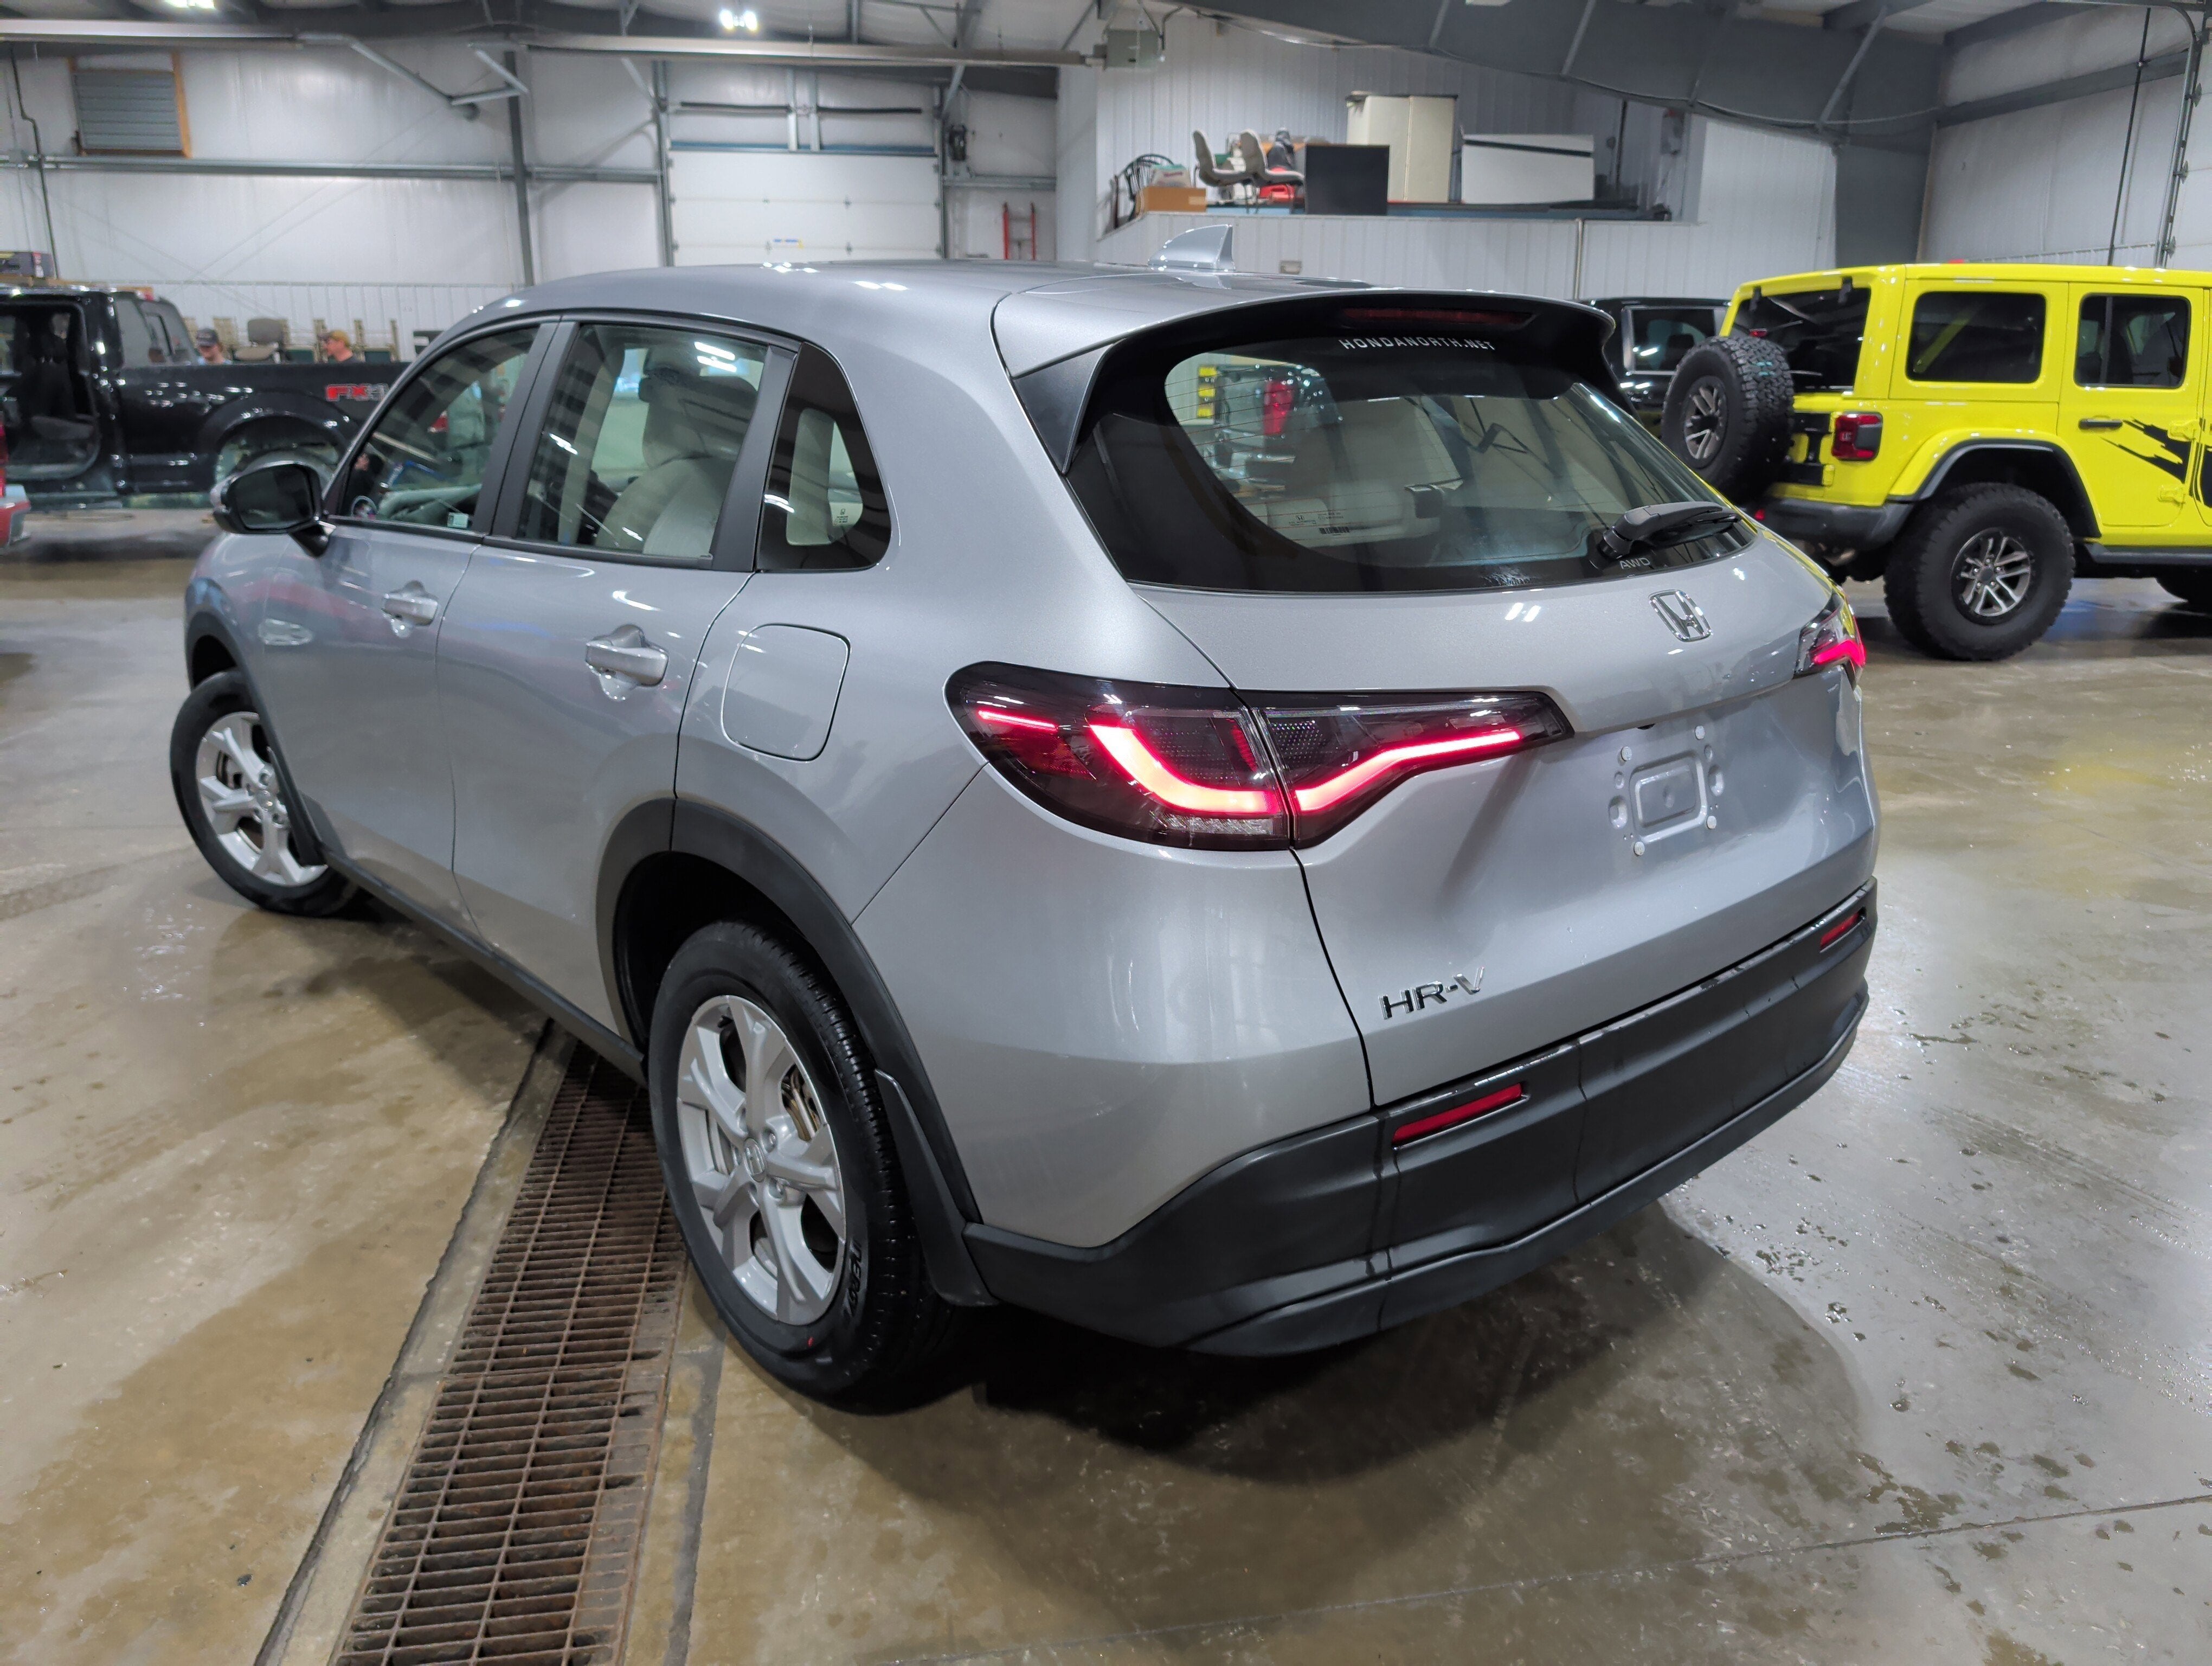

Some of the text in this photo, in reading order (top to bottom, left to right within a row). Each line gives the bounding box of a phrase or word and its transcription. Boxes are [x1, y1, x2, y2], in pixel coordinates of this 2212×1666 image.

[1338, 336, 1496, 351] HONDANORTH.NET
[1619, 557, 1651, 569] AWD
[1378, 966, 1485, 1020] HR-V
